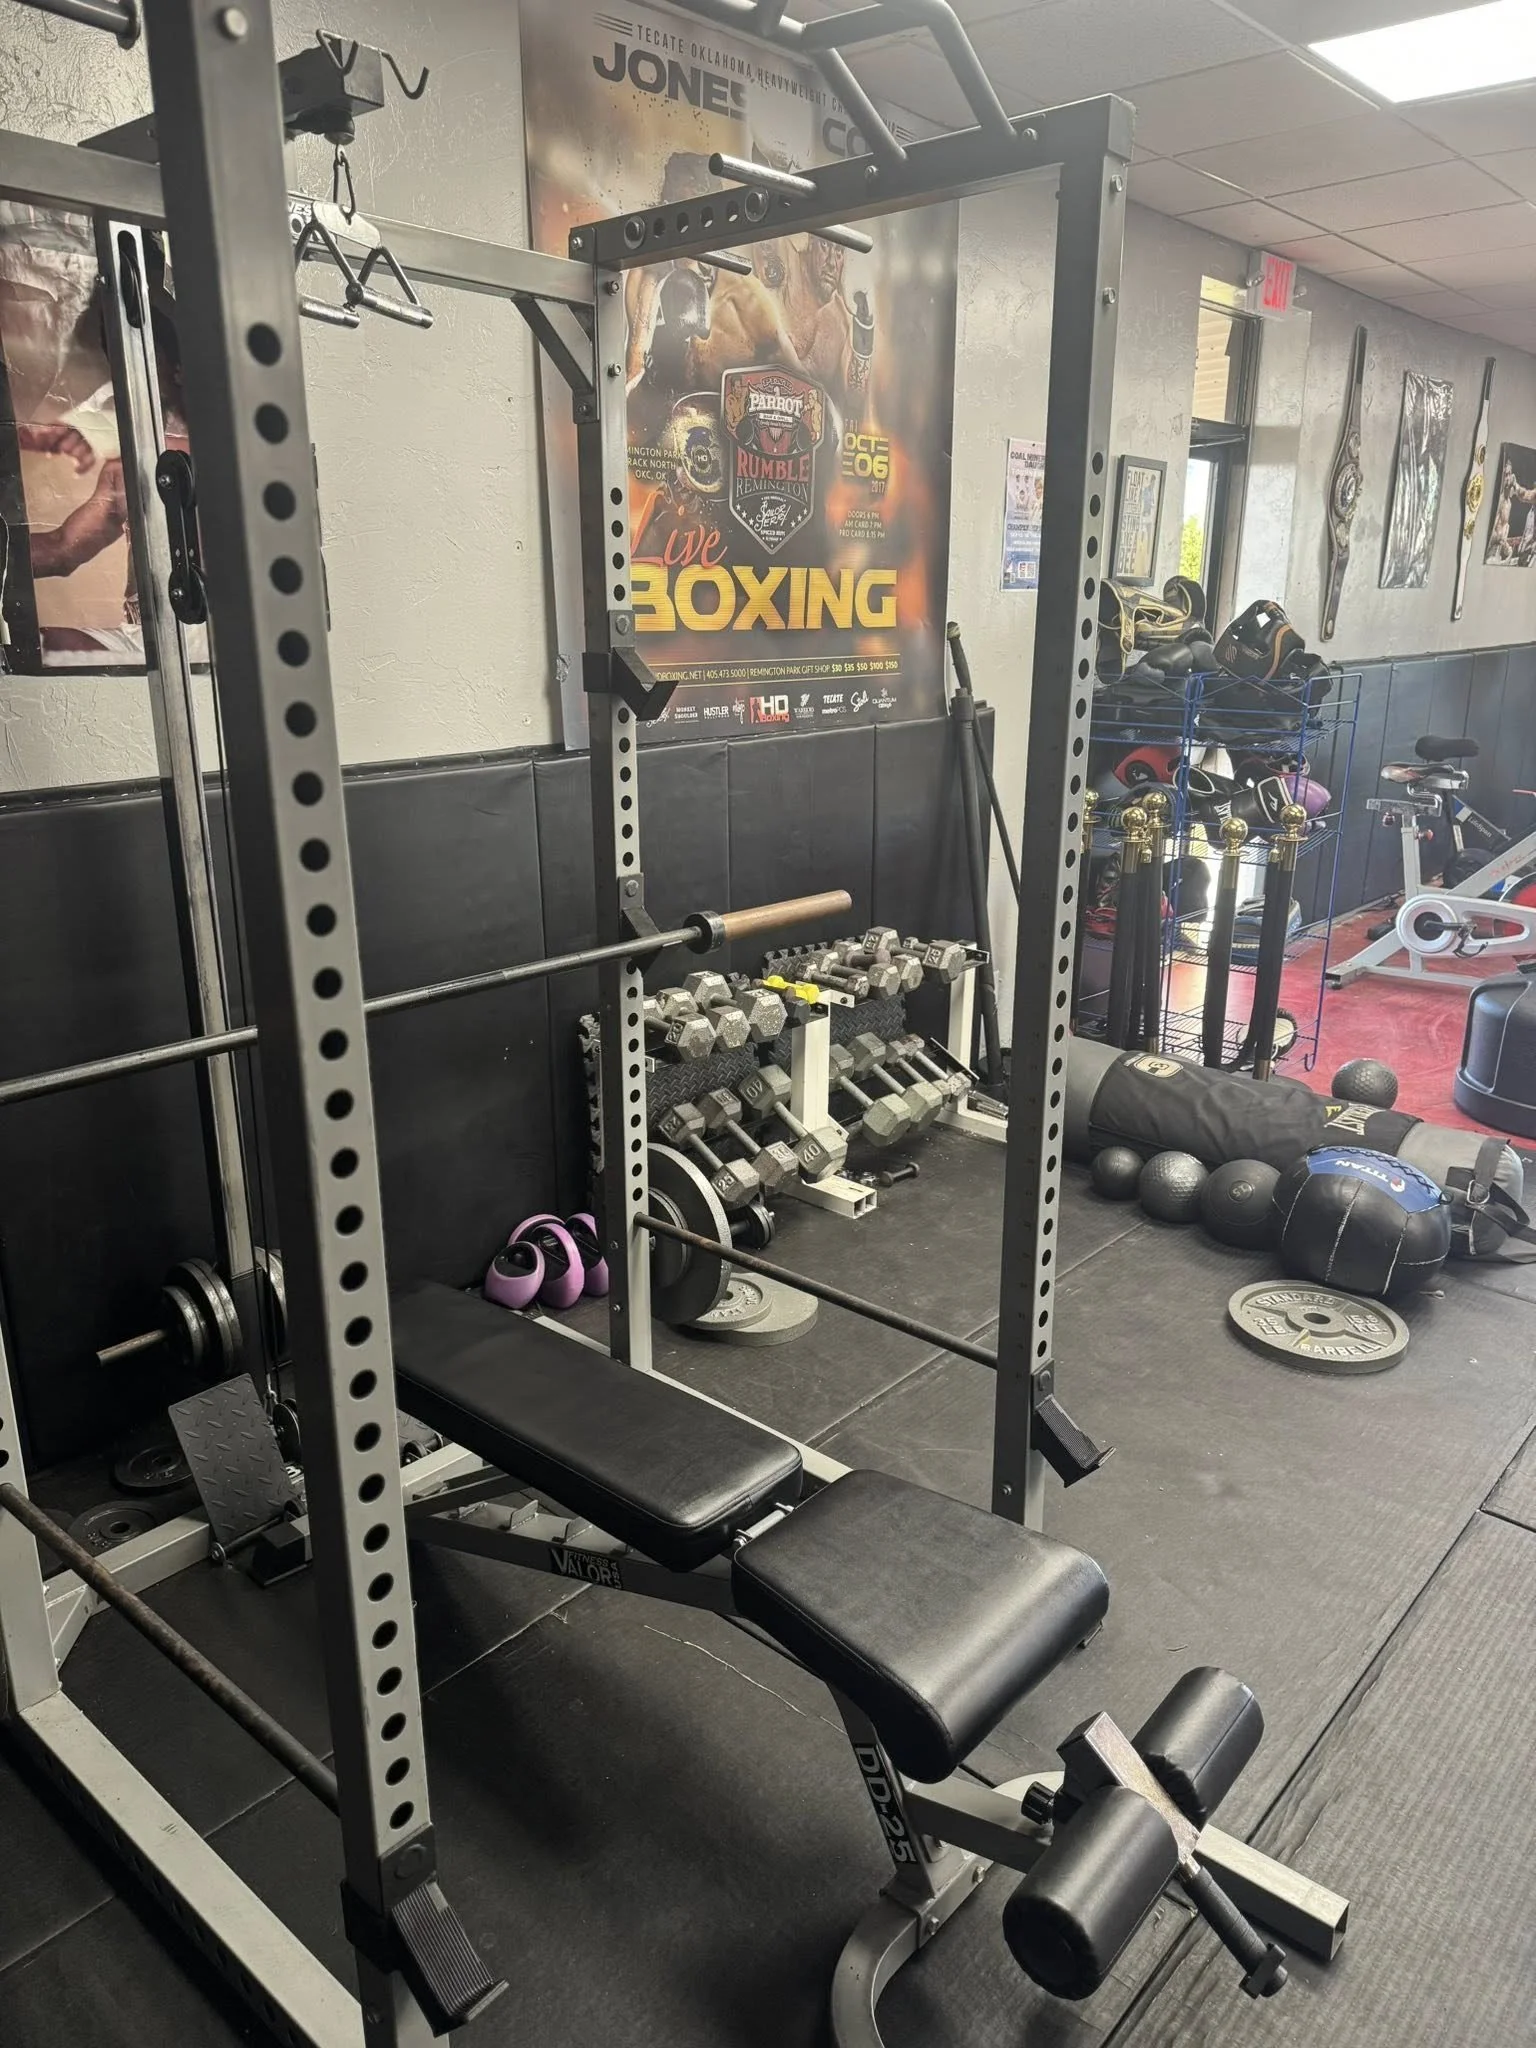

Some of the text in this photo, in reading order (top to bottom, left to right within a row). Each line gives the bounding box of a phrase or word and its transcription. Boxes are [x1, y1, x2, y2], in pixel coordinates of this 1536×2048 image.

[637, 24, 827, 108] TECATE OKLAHOMA HEAVYWEIGHT
[748, 391, 804, 418] PARROT
[663, 448, 682, 459] PARK
[649, 459, 676, 471] NORTH
[736, 446, 810, 482] RUMBLE
[853, 452, 889, 479] 06
[635, 469, 667, 481] OKC, OK
[736, 477, 809, 502] REMINGTON
[871, 480, 885, 495] 2017
[844, 520, 854, 528] AM
[854, 520, 869, 529] CARD
[873, 521, 882, 529] PM
[847, 510, 866, 519] DOORS
[871, 511, 880, 520] PM
[630, 488, 728, 569] Live
[839, 529, 850, 537] PRO
[851, 529, 866, 538] CARD
[877, 531, 886, 539] PM
[706, 668, 746, 680] 405.473.5000
[750, 667, 786, 676] REMINGTON
[786, 666, 801, 675] PARK
[801, 665, 815, 674] GIFT
[815, 664, 831, 673] SHOP
[831, 663, 843, 673] $30
[844, 663, 855, 672] $35
[856, 662, 868, 672] $50
[870, 661, 884, 671] $100
[703, 705, 729, 716] HUSTLER
[761, 694, 789, 715] HD
[1467, 816, 1492, 838] LifeSpan
[746, 1078, 763, 1099] 40
[802, 1143, 821, 1163] 40
[1335, 1160, 1389, 1182] TITAN
[718, 1173, 735, 1191] 25
[1255, 1292, 1336, 1307] STANDARD
[1253, 1316, 1278, 1326] 35
[1300, 1343, 1383, 1356] BARBELL
[551, 1548, 612, 1585] VALOR
[568, 1551, 609, 1567] FITNESS
[854, 1746, 917, 1862] DD-25
